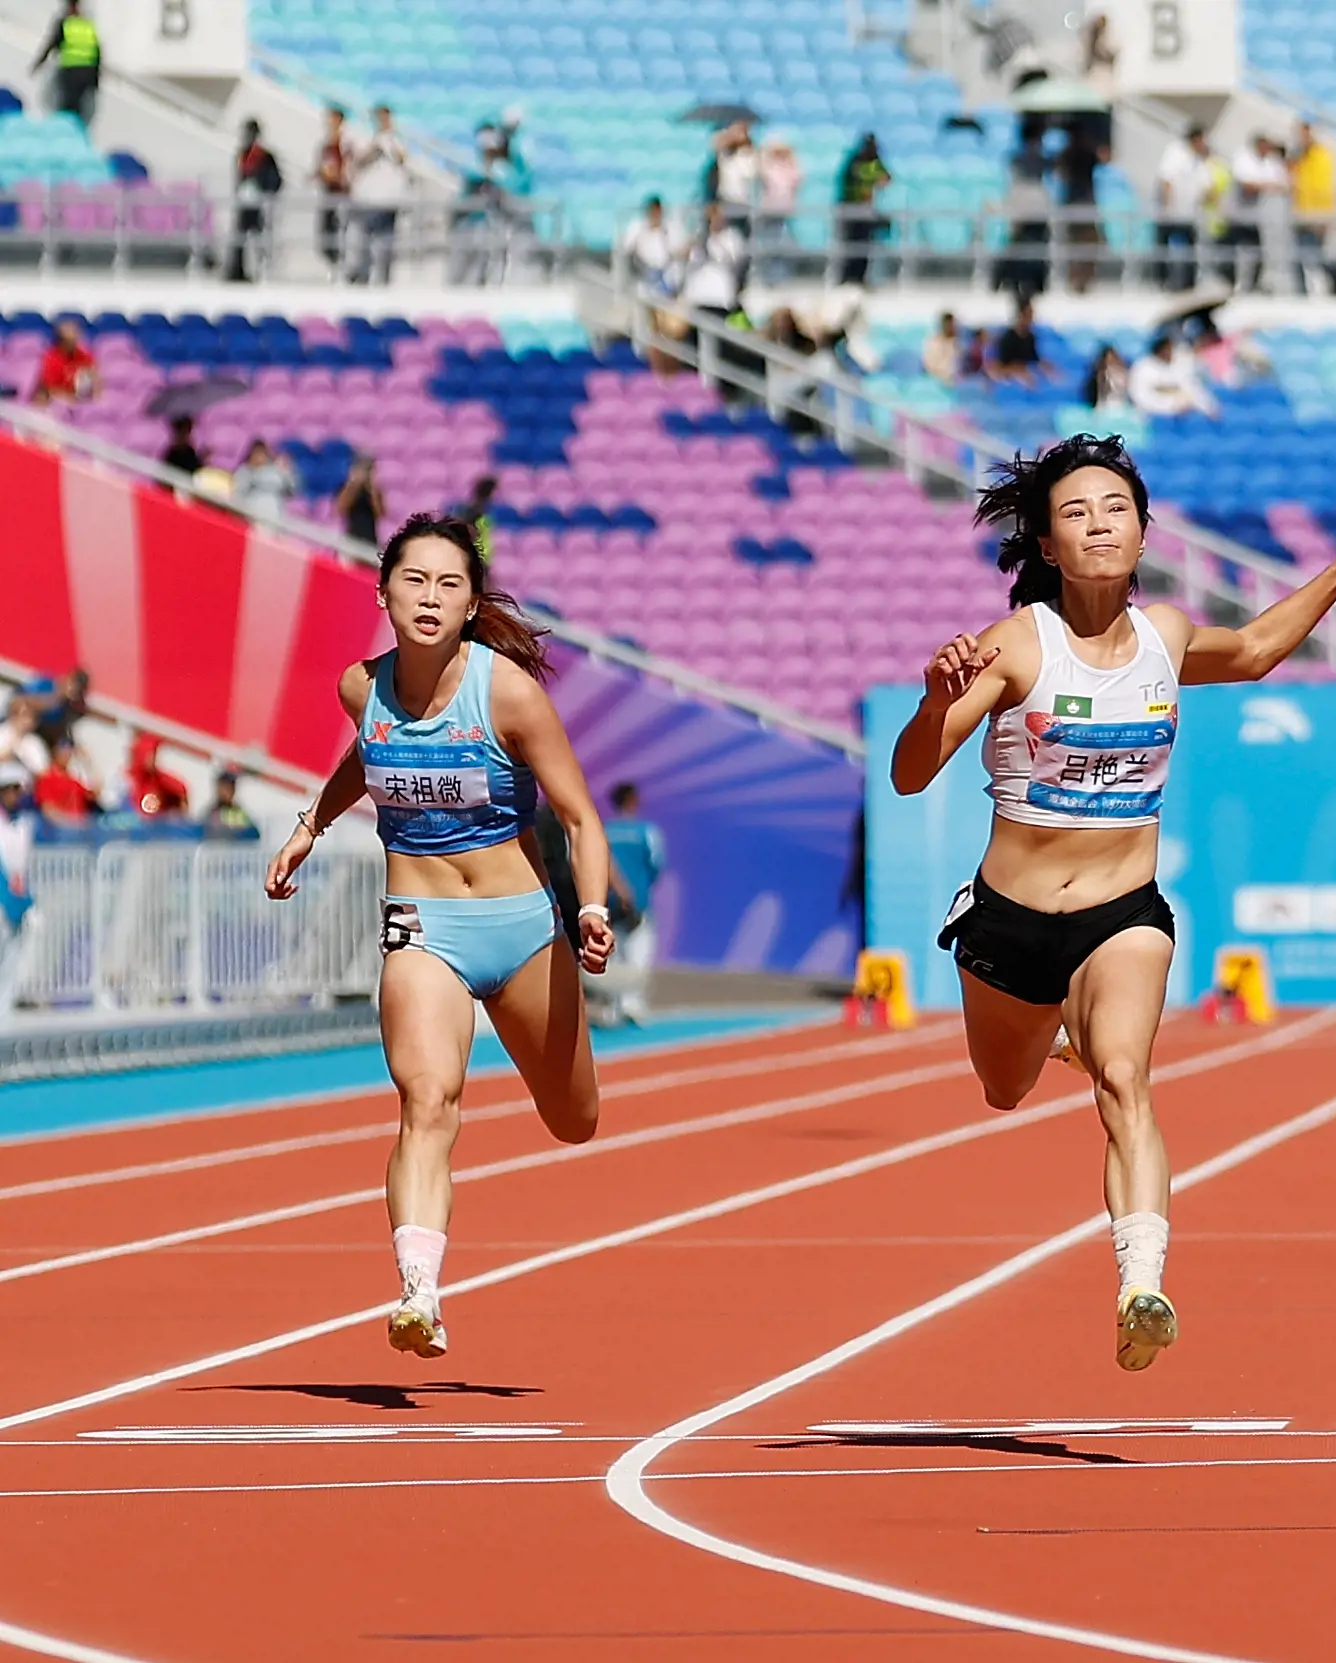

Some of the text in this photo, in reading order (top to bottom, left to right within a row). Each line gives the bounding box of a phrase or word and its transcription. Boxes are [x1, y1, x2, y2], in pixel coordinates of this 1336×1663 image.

[1150, 2, 1183, 59] B
[448, 723, 484, 742] 江西
[1060, 753, 1149, 786] 吕艳兰
[385, 774, 465, 804] 宋祖微
